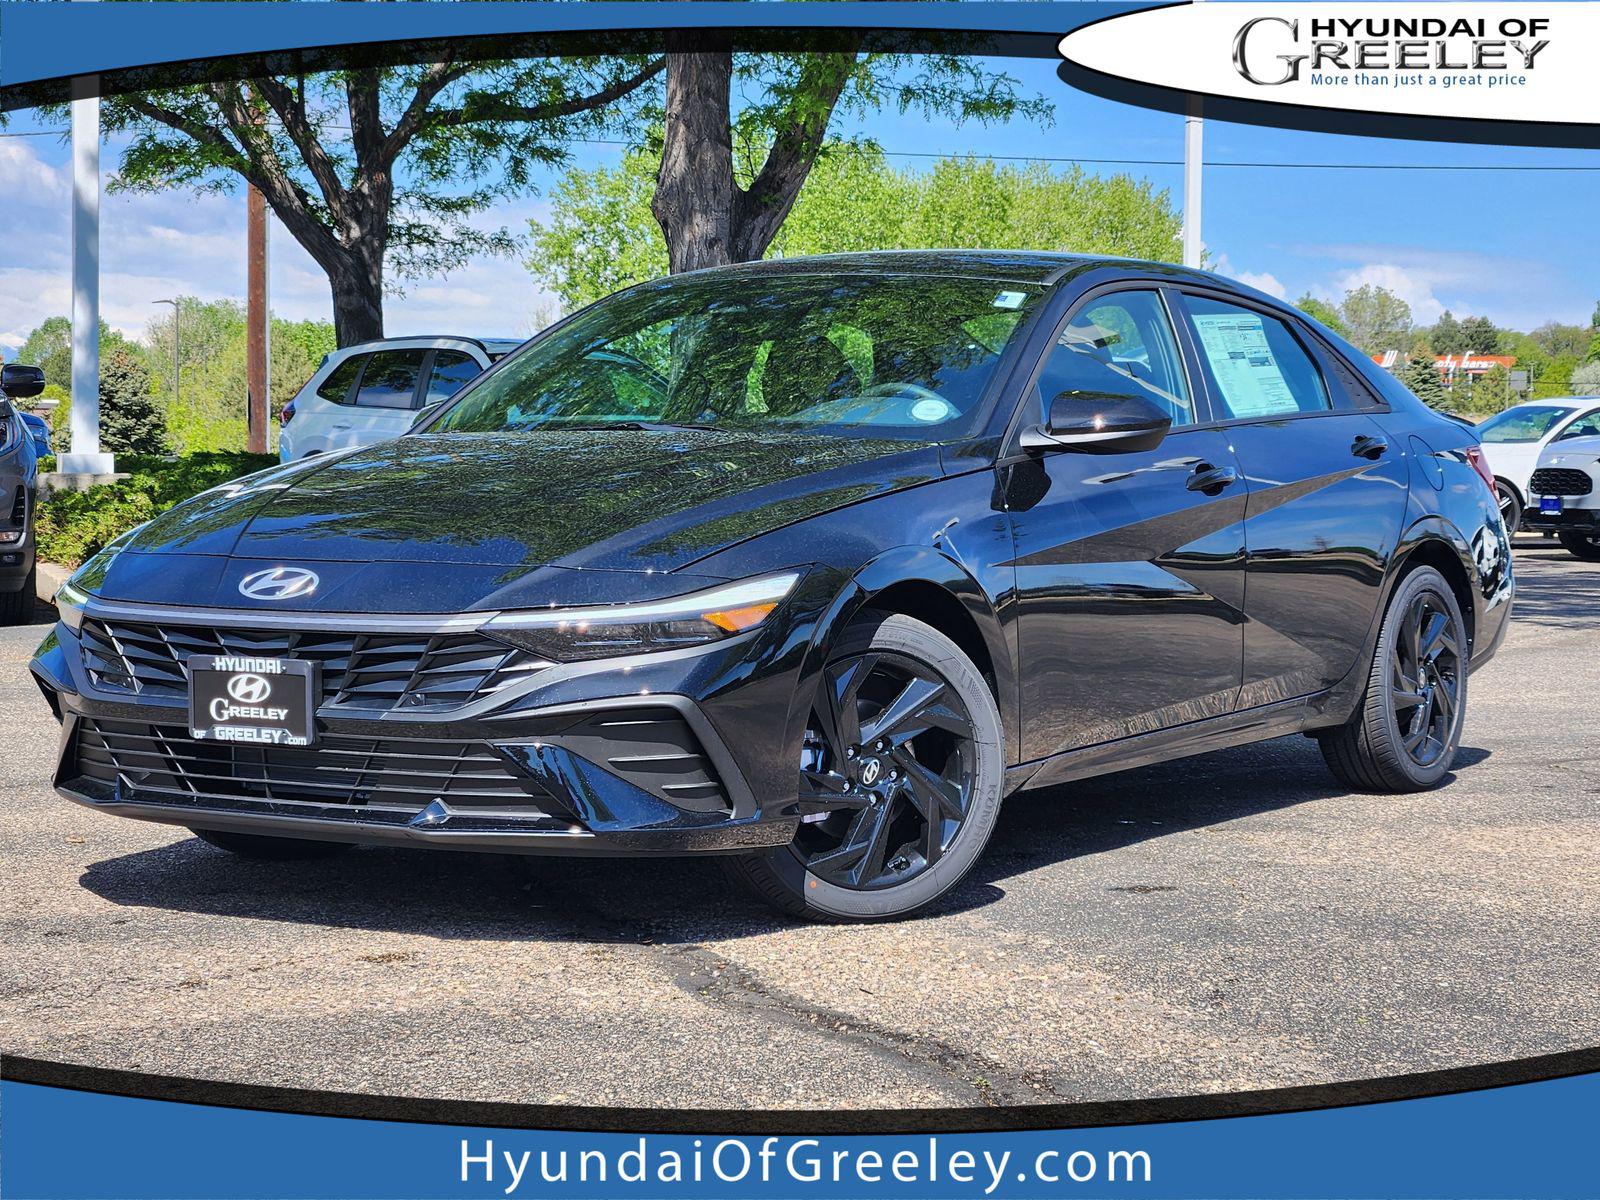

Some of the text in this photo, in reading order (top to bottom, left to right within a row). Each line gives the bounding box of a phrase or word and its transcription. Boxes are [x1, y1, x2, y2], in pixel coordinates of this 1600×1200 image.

[214, 657, 282, 674] HYUNDAI
[209, 697, 289, 722] GREELEY
[193, 728, 207, 740] OF
[214, 726, 282, 744] GREELEY
